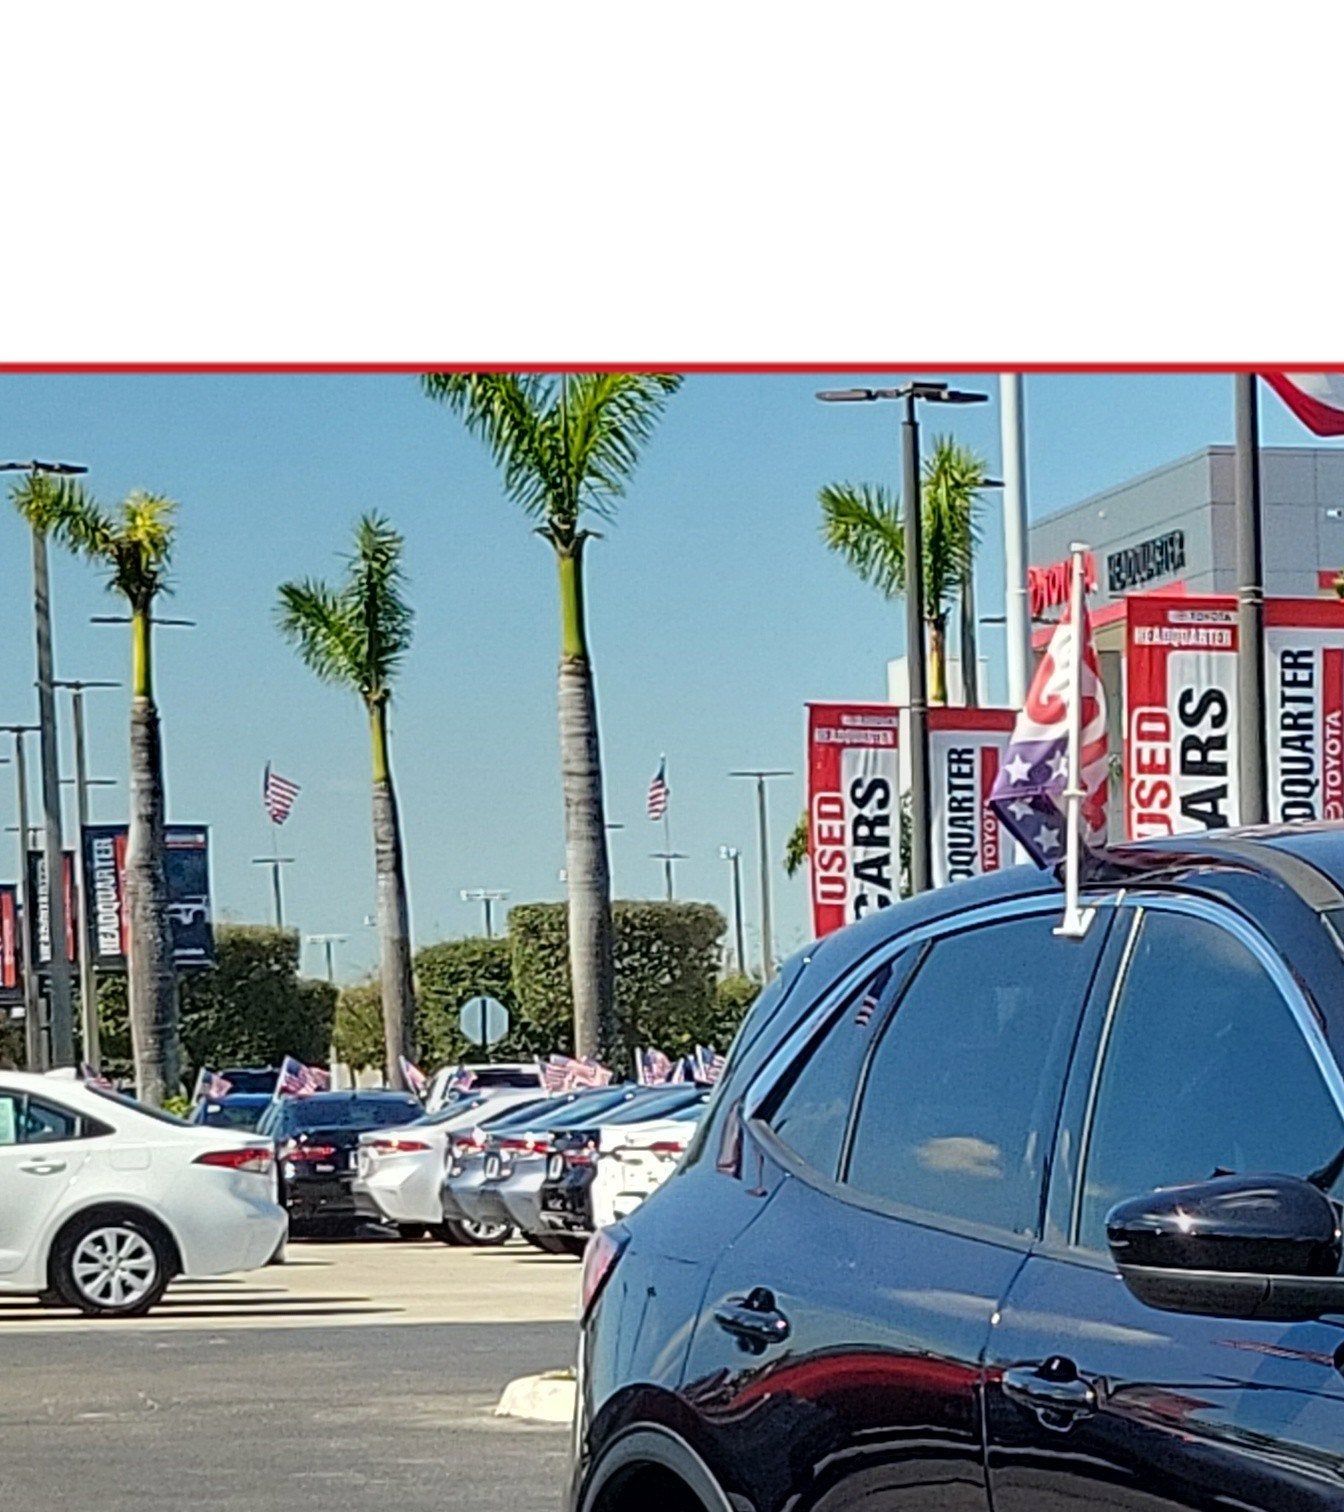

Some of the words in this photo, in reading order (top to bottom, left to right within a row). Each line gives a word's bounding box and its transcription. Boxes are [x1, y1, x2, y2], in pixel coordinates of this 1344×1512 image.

[1132, 706, 1174, 839] USED
[1178, 688, 1231, 829] ARS
[1280, 649, 1319, 823] DQUARTER
[1325, 710, 1342, 800] TOYOTA
[813, 791, 849, 905] USED
[947, 747, 976, 882] DQUARTER
[983, 799, 996, 869] TOYOT
